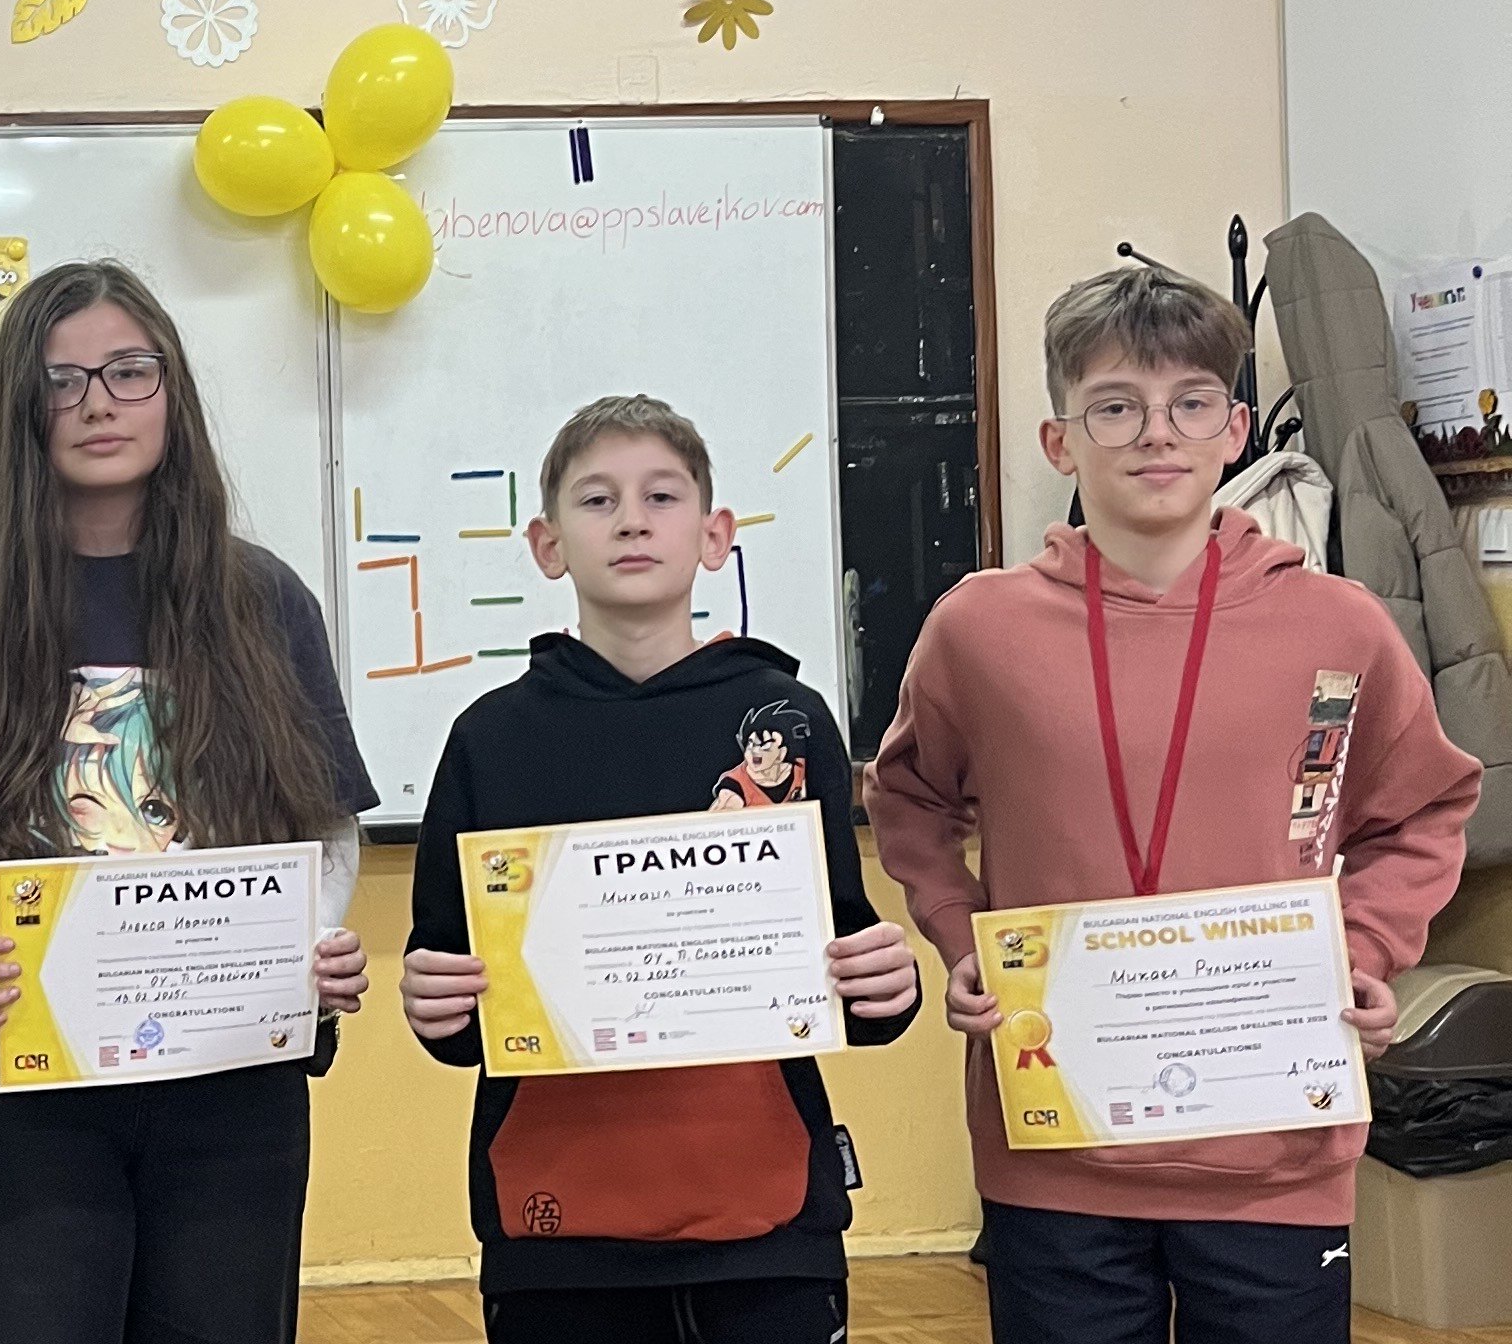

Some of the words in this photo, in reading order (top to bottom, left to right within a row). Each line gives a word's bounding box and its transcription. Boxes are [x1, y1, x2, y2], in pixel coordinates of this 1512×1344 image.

[572, 838, 628, 851] BULGARIAN
[631, 834, 679, 846] NATIONAL
[683, 829, 724, 841] ENGLISH
[727, 825, 773, 837] SPELLING
[777, 823, 796, 833] BEE
[150, 868, 195, 878] NATIONAL
[198, 865, 235, 875] ENGLISH
[237, 862, 279, 872] SPELLING
[282, 861, 298, 869] BEE
[594, 839, 780, 876] ГРАМОТА
[115, 875, 282, 906] ГРАМОТА
[600, 889, 671, 906] Михаил
[685, 880, 763, 897] Атанасов
[1083, 915, 1138, 929] BULGARIAN
[1141, 910, 1192, 923] NATIONAL
[1194, 905, 1236, 918] ENGLISH
[1239, 901, 1287, 914] SPELLING
[1290, 898, 1310, 909] BEE
[681, 938, 718, 947] ENGLISH
[720, 934, 760, 944] SPELLING
[763, 933, 779, 941] BEE
[1084, 925, 1195, 951] SCHOOL
[1201, 912, 1315, 941] WINNER
[644, 984, 752, 1000] CONGRATULATIONS!
[148, 1005, 244, 1020] CONGRATULATIONS!
[1097, 1032, 1148, 1043] BULGARIAN
[1151, 1027, 1196, 1038] NATIONAL
[1199, 1023, 1237, 1033] ENGLISH
[1240, 1019, 1283, 1030] SPELLING
[1287, 1017, 1303, 1025] BEE
[1157, 1043, 1262, 1060] CONGRATULATIONS!
[524, 1192, 561, 1234] 悟
